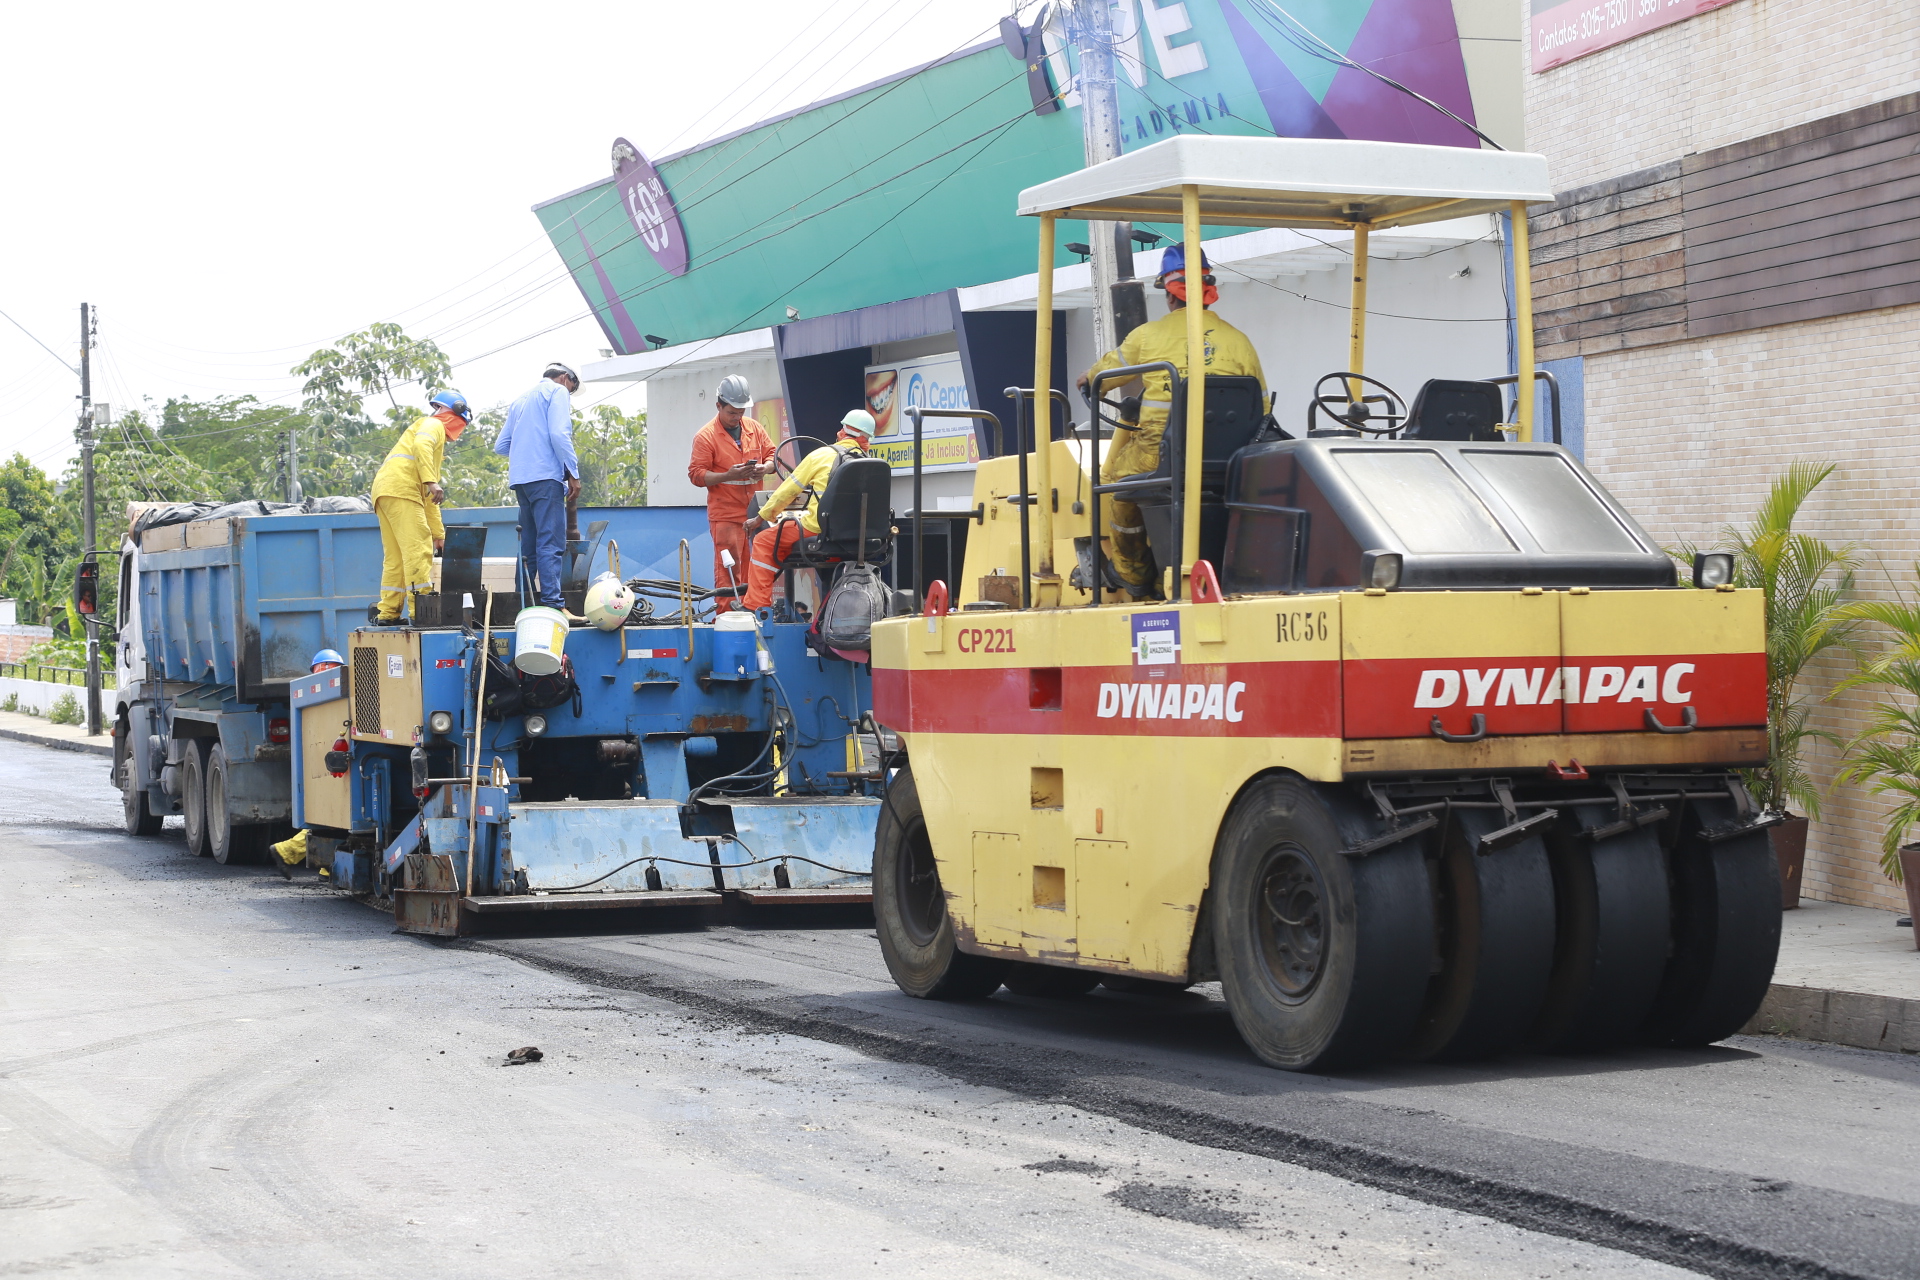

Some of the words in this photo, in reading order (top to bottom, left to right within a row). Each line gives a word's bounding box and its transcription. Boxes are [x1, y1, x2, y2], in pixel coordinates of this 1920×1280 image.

[1538, 20, 1579, 53] Contatos:
[1580, 0, 1628, 40] 3015-7500
[1119, 92, 1231, 143] CADEMIA
[929, 381, 970, 409] Cepro
[886, 445, 914, 466] Aparelh
[926, 443, 935, 459] Já
[937, 441, 966, 458] Incluso
[1147, 618, 1170, 628] SERVIÇO
[1276, 610, 1328, 643] RC56
[957, 627, 1017, 653] CP221
[1149, 646, 1172, 655] AMAZONAS
[1413, 662, 1696, 709] DYNAPAC
[1096, 680, 1246, 723] DYNAPAC
